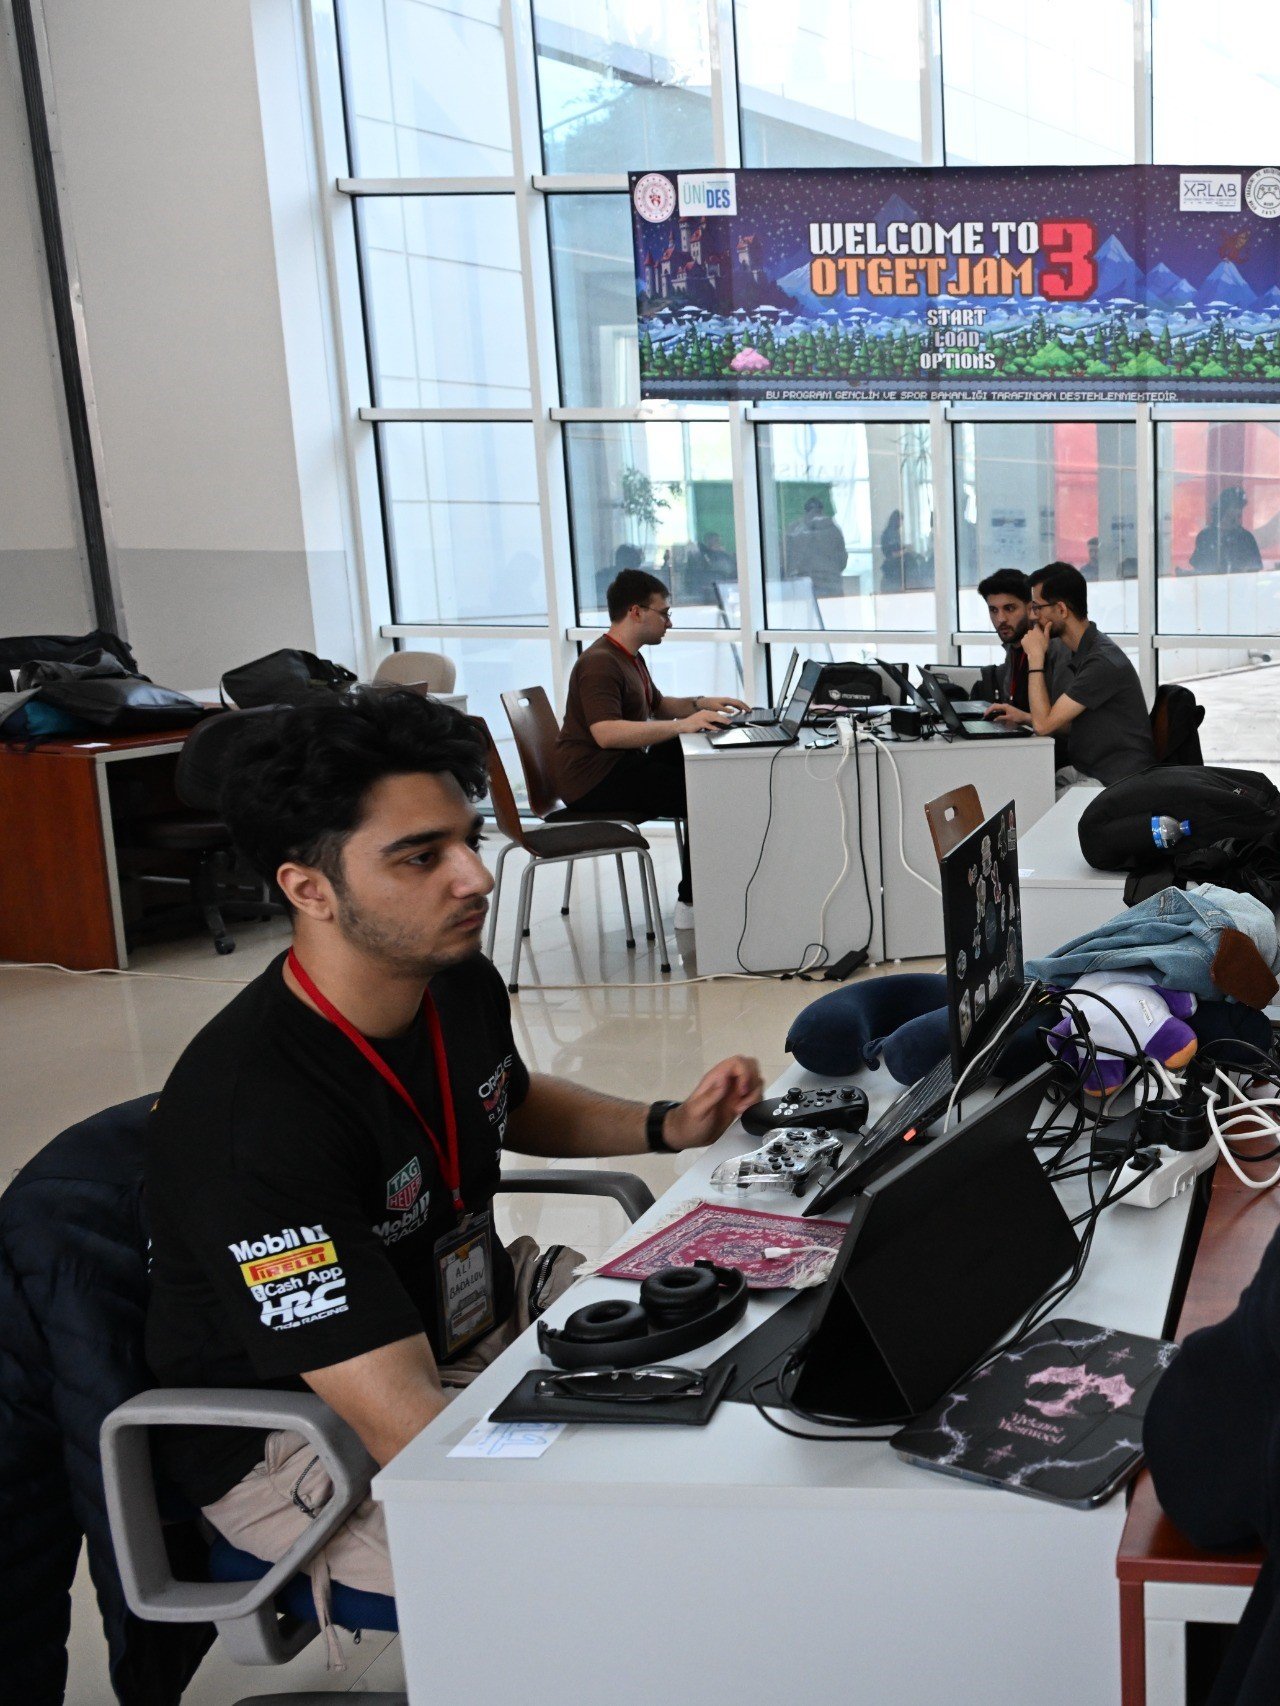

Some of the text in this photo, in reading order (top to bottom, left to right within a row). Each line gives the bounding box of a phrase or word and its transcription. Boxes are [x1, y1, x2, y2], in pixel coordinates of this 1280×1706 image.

[706, 189, 731, 209] DES
[1183, 183, 1237, 197] XRLAB
[809, 222, 1039, 254] WELCOME TO
[1042, 221, 1097, 299] 3
[927, 309, 987, 326] START
[934, 331, 980, 348] LOAD
[920, 353, 996, 370] OPTIONS
[765, 391, 780, 400] BU
[782, 391, 832, 400] PROGRAM
[834, 390, 880, 401] GENÇLİK
[883, 391, 897, 400] VE
[900, 391, 927, 400] SPOR
[930, 390, 987, 400] BAKANLIĞI
[991, 391, 1056, 400] TARAFINDAN
[390, 1162, 418, 1191] TAG
[372, 1203, 419, 1237] Mobil
[384, 1207, 429, 1246] RACLE
[228, 1228, 301, 1263] Mobil
[248, 1246, 327, 1281] PIRELLI
[264, 1266, 343, 1297] Cash App
[260, 1277, 347, 1327] HRC
[301, 1304, 350, 1325] RACING
